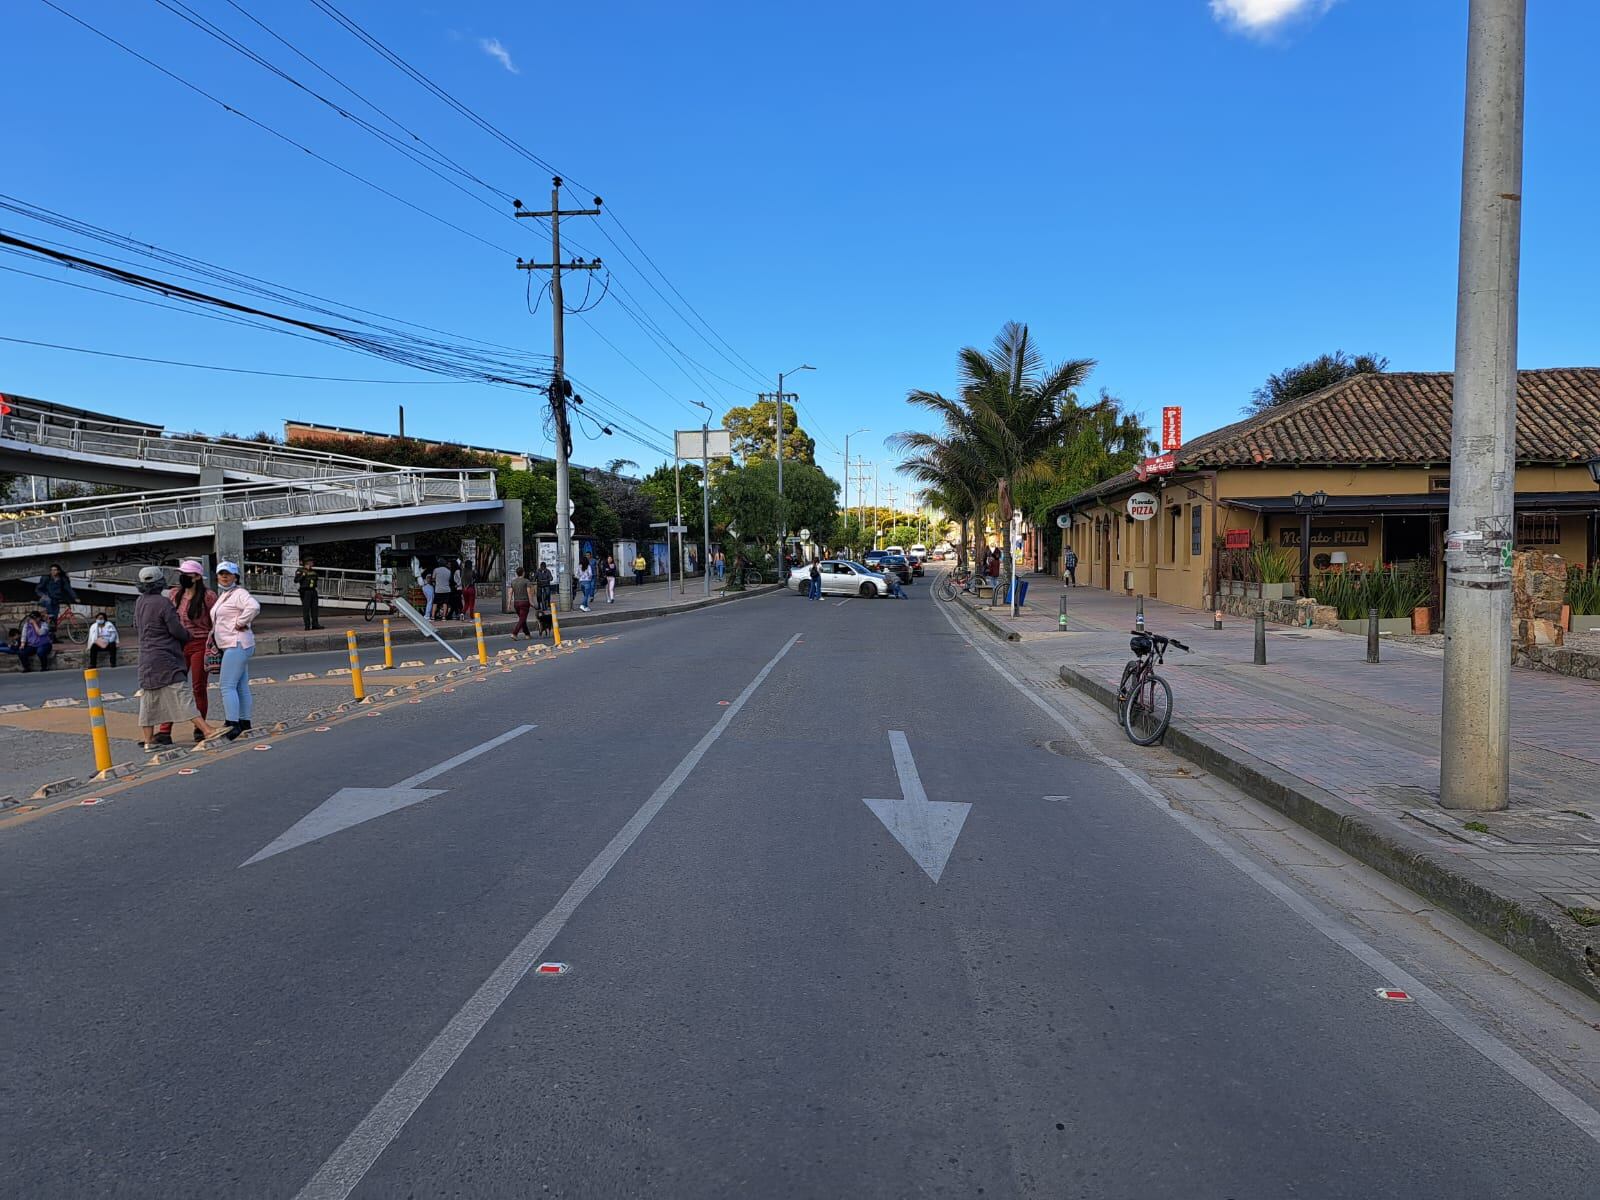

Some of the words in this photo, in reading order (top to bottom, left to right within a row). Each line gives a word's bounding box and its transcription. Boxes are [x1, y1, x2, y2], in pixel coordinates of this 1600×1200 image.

[1167, 410, 1176, 446] PIZZA
[1131, 506, 1154, 515] PIZZA
[1281, 531, 1332, 546] Noato
[1334, 531, 1366, 543] PIZZA
